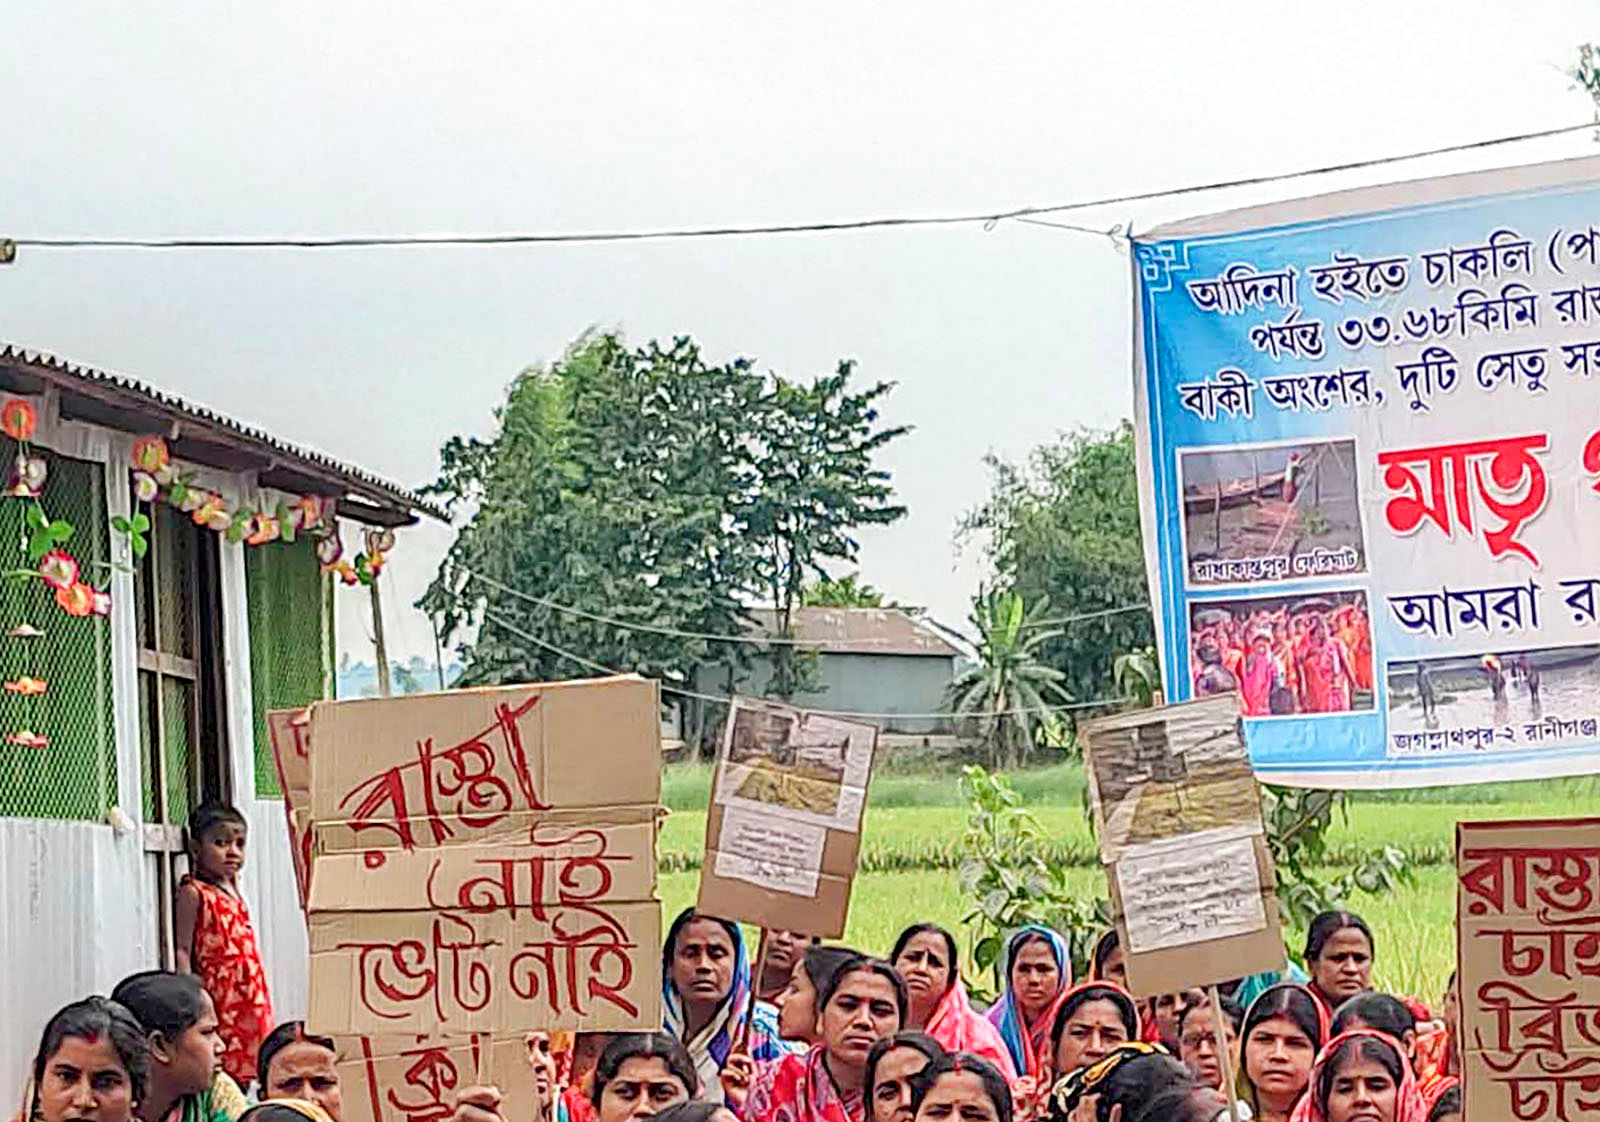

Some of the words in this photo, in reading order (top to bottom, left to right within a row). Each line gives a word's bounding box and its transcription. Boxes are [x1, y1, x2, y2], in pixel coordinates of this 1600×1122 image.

[1188, 265, 1296, 316] আদিনা
[1309, 254, 1409, 305] হইতে
[1422, 231, 1532, 287] চাকলি
[1250, 311, 1323, 359] পর্যন্ত
[1336, 284, 1537, 347] ৩৩.৬৮কিমি
[1180, 369, 1256, 422] বাকী
[1264, 367, 1385, 411] অংশের,
[1395, 346, 1460, 413] দুটি
[1476, 347, 1550, 393] সেতু
[1377, 432, 1549, 567] মাতৃ
[1387, 578, 1543, 639] আমরা
[338, 695, 554, 869] রাস্তা
[336, 912, 502, 1022] ভোট
